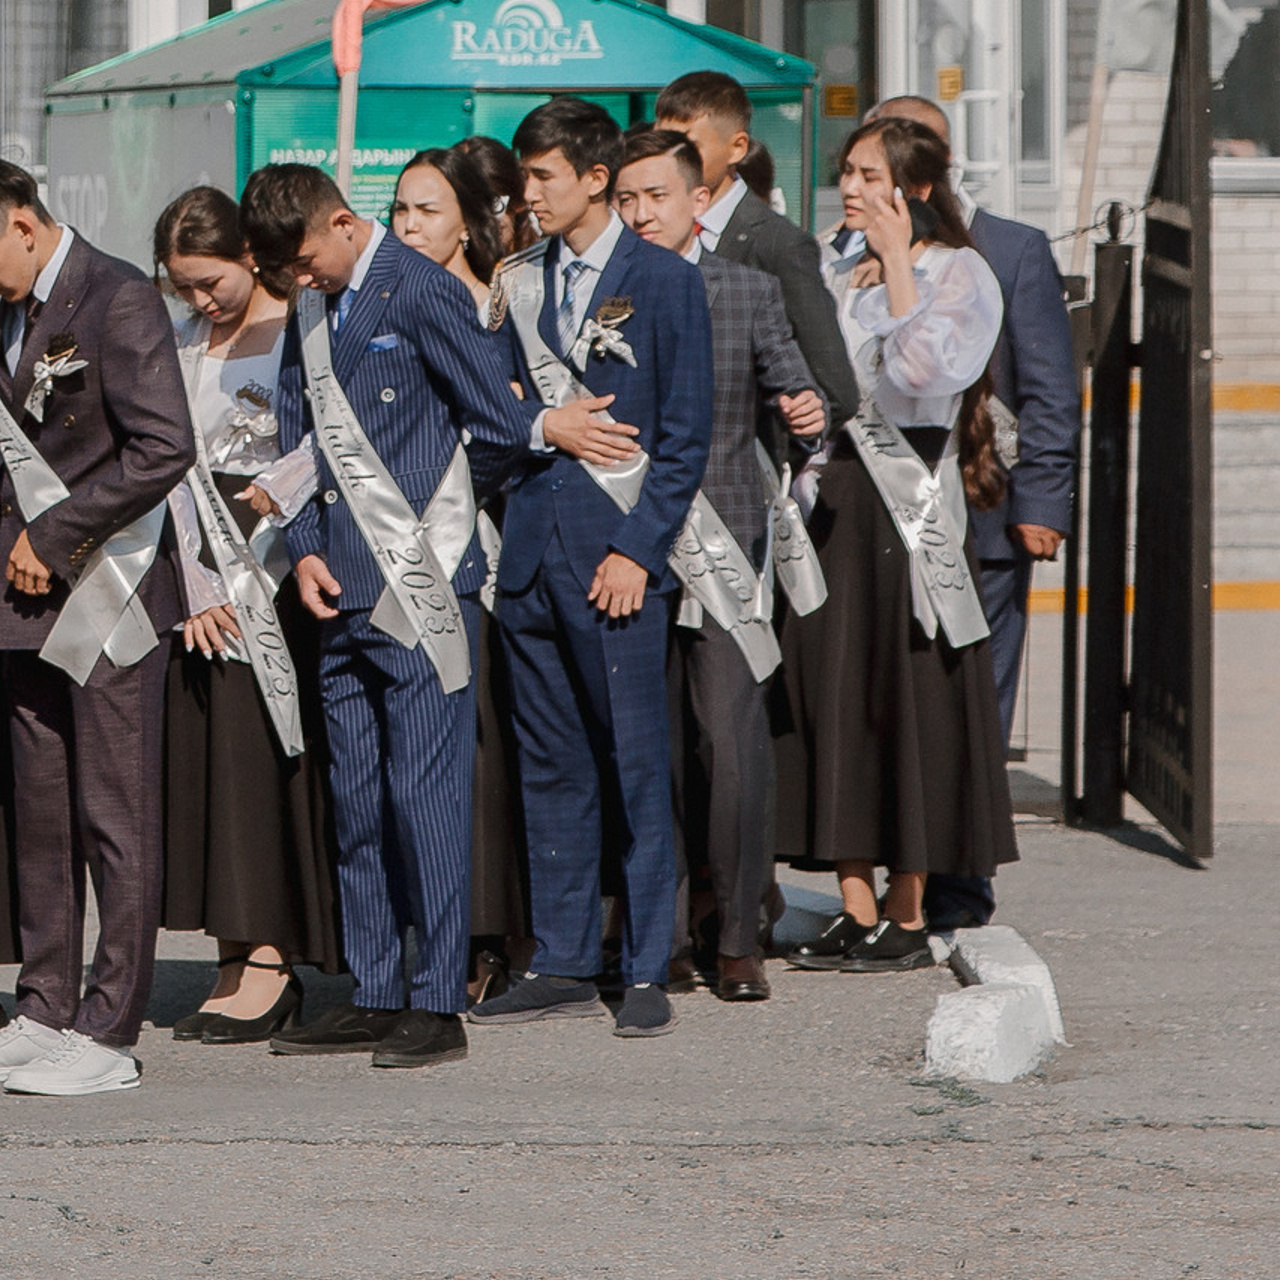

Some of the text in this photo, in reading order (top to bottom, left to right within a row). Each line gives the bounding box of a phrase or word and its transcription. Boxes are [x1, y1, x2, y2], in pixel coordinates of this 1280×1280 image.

[451, 20, 603, 52] RADUGA
[270, 148, 327, 165] НАЗАР
[388, 546, 457, 636] 2023
